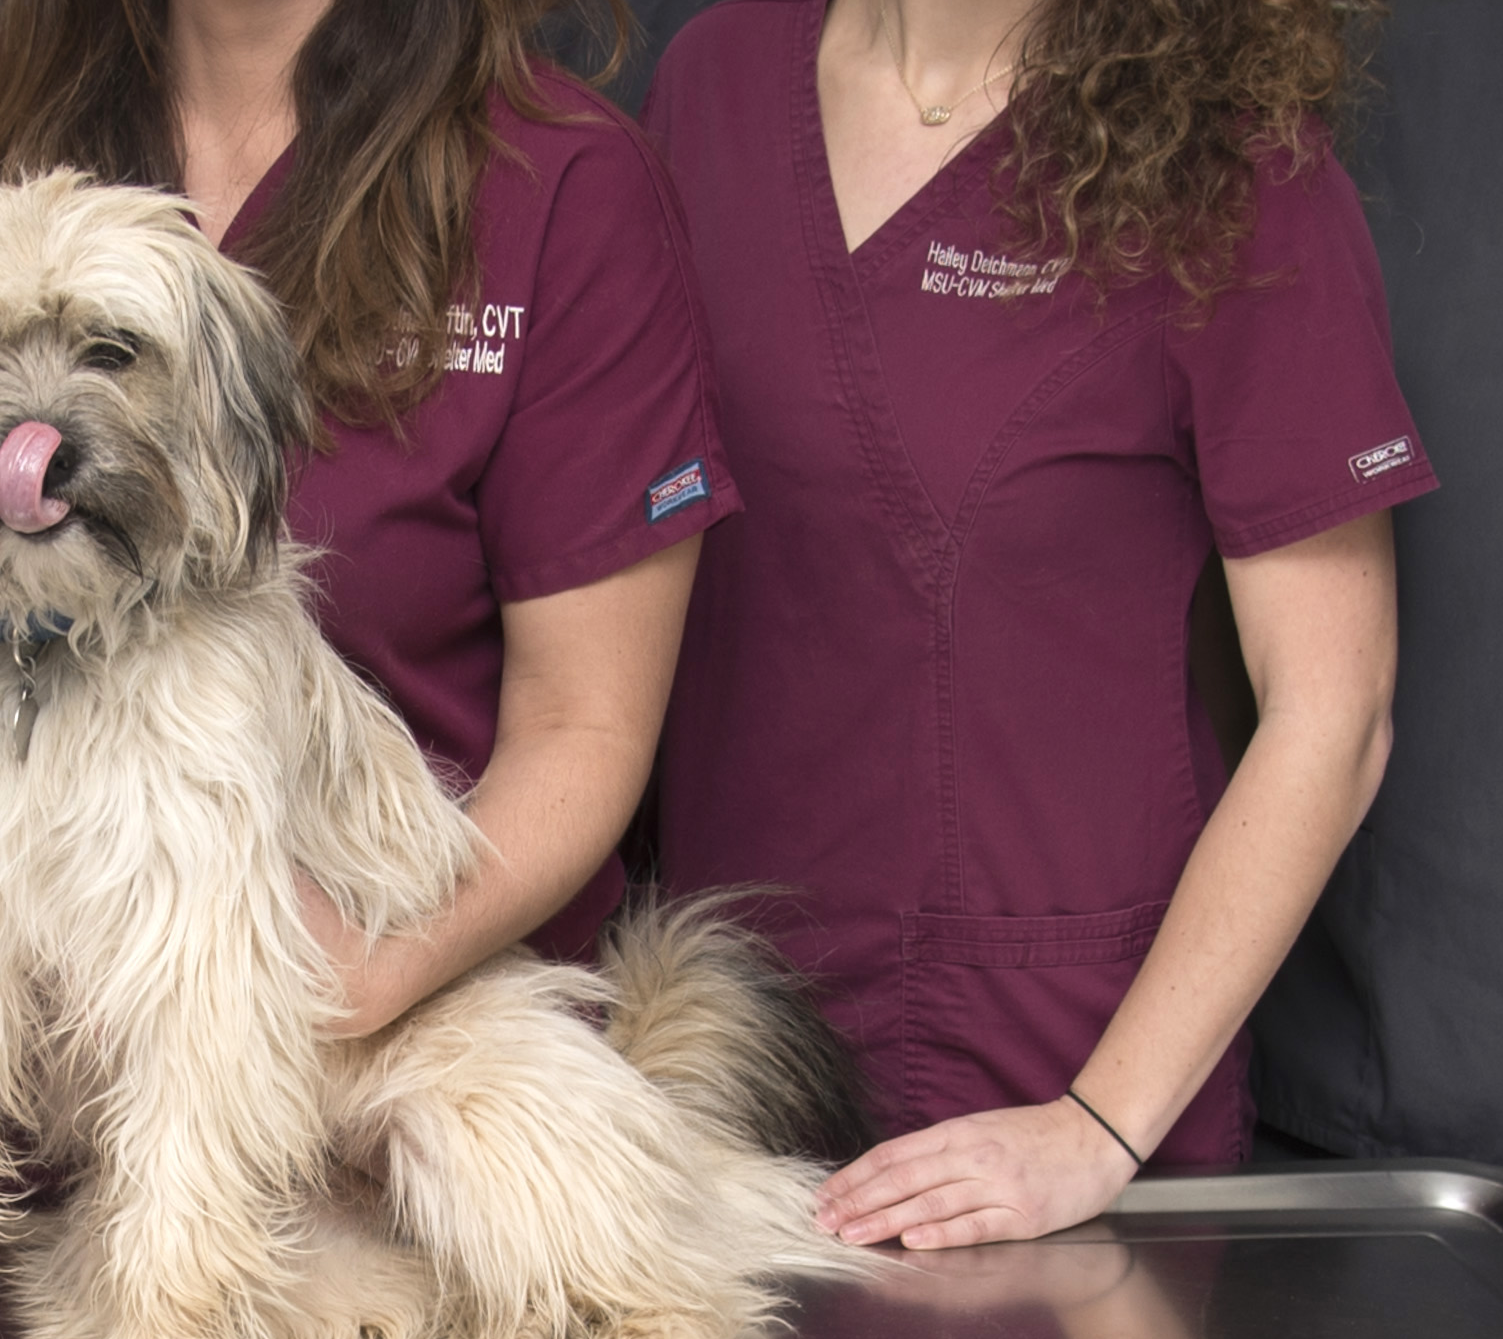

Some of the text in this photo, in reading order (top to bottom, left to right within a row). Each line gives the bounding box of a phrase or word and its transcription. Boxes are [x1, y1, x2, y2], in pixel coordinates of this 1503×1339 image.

[926, 240, 970, 277] Hailey
[920, 268, 990, 299] MSU-CVM
[481, 303, 525, 339] CVT
[472, 340, 505, 375] Med
